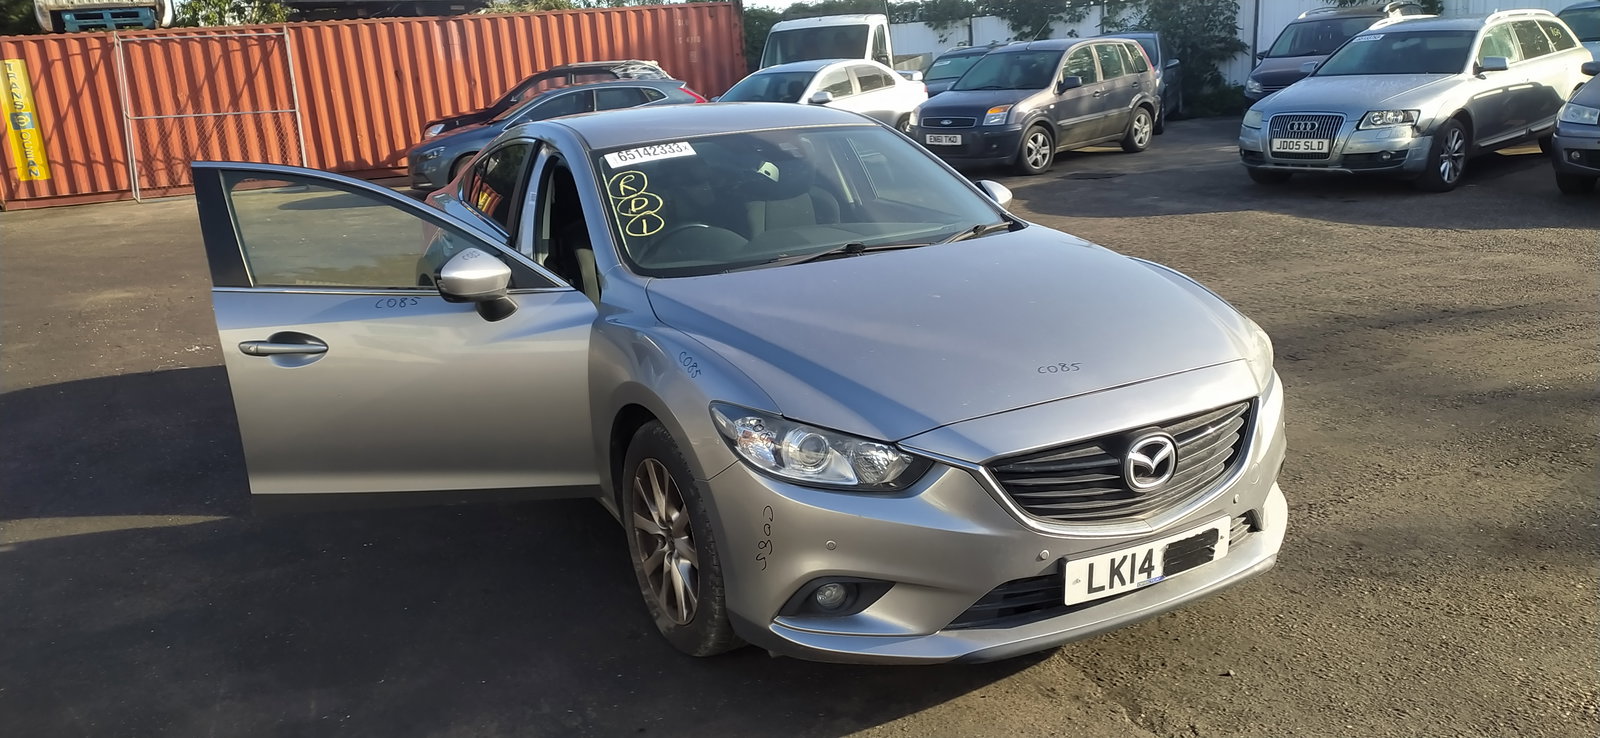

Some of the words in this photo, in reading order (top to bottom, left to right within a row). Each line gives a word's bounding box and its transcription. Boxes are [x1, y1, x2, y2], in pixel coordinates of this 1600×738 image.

[1276, 140, 1301, 150] JD05
[1303, 141, 1324, 151] SLD
[1087, 548, 1155, 595] LK14
